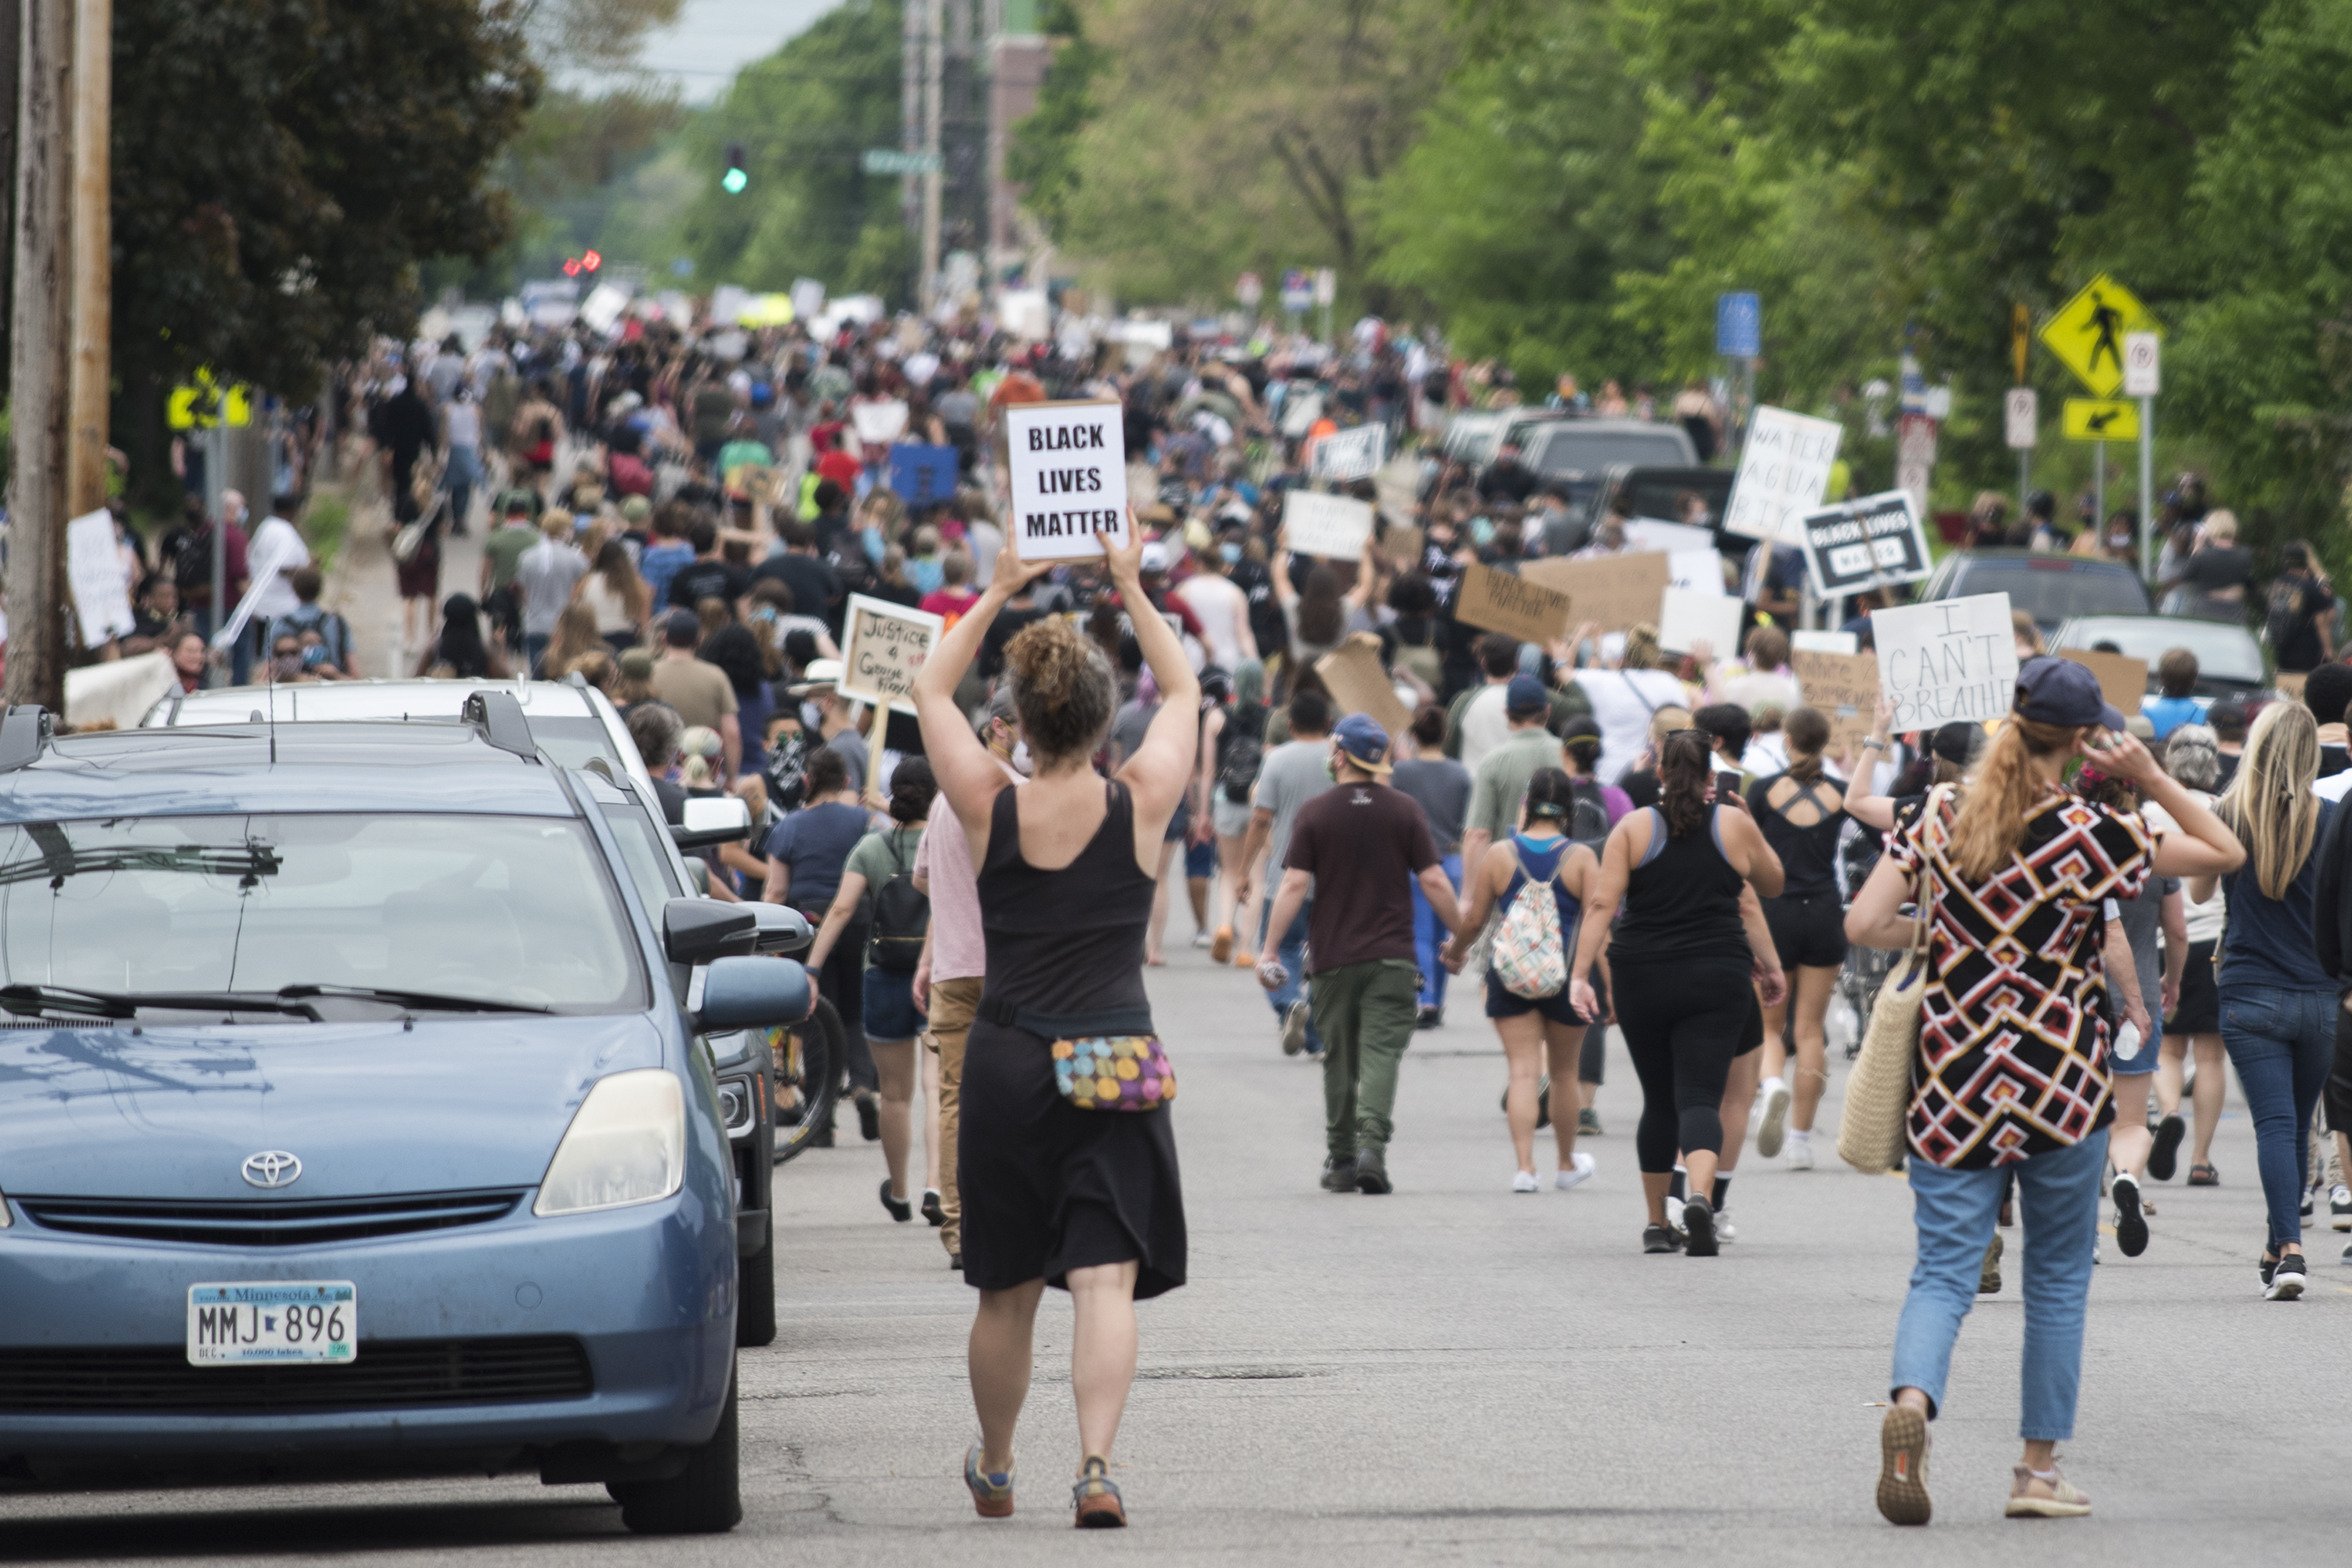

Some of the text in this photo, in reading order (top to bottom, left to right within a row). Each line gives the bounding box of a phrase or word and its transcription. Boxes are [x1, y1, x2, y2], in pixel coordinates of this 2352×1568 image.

[1028, 424, 1105, 452] BLACK
[1754, 426, 1831, 466] WATER
[1038, 467, 1102, 494] LIVES
[1742, 459, 1820, 502] AGUA
[1026, 510, 1120, 538] MATTER
[1732, 494, 1804, 535] BIY
[1811, 510, 1910, 547] BLACK LIVES
[1840, 545, 1896, 567] MATER
[1935, 604, 1969, 637] I
[887, 646, 898, 661] 4
[1889, 633, 2000, 691] CAN'T
[198, 1305, 345, 1345] MMJ 896
